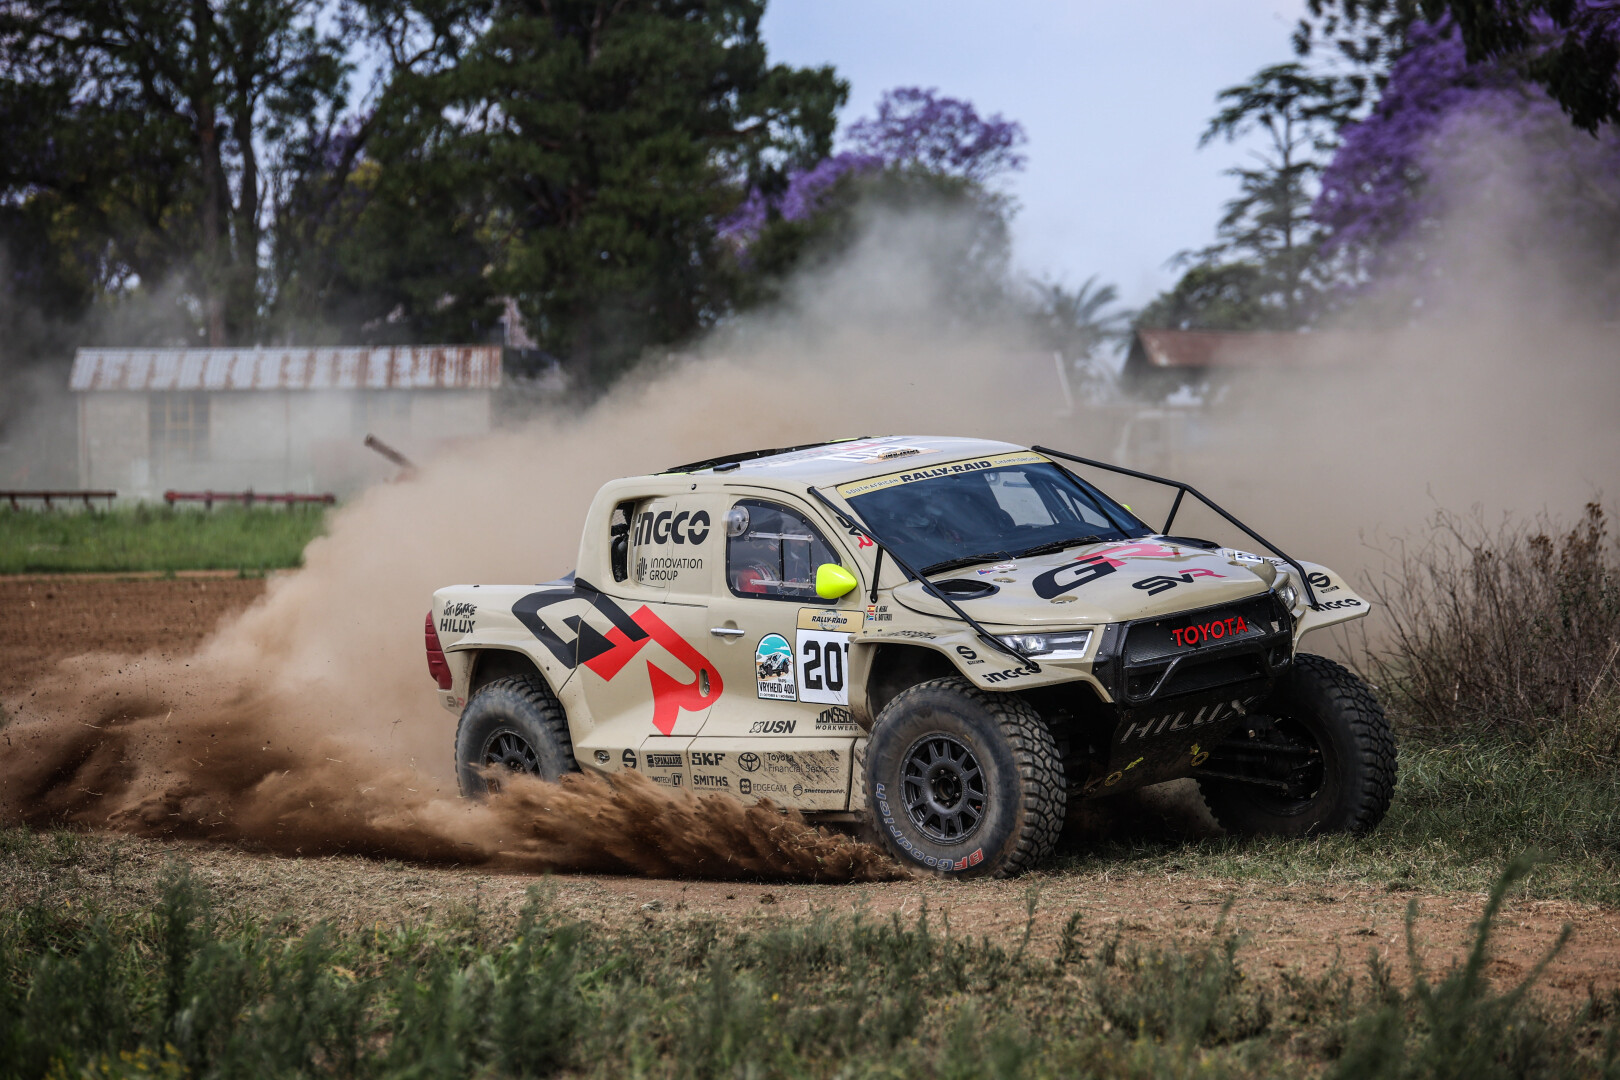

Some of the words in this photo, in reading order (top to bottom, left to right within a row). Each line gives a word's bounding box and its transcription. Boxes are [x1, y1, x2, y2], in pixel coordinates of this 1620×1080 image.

[900, 460, 992, 483] RALLY-RAID
[650, 557, 704, 570] INNOVATION
[649, 569, 679, 582] GROUP
[439, 618, 476, 634] HILUX
[811, 615, 848, 625] RALLY-RAID
[1171, 615, 1248, 648] TOYOTA
[759, 681, 783, 694] VRYHEID
[783, 684, 795, 695] 400
[762, 720, 796, 733] USN
[691, 752, 726, 766] SKF
[693, 774, 729, 787] SMITHS
[752, 783, 788, 793] EDGECAM
